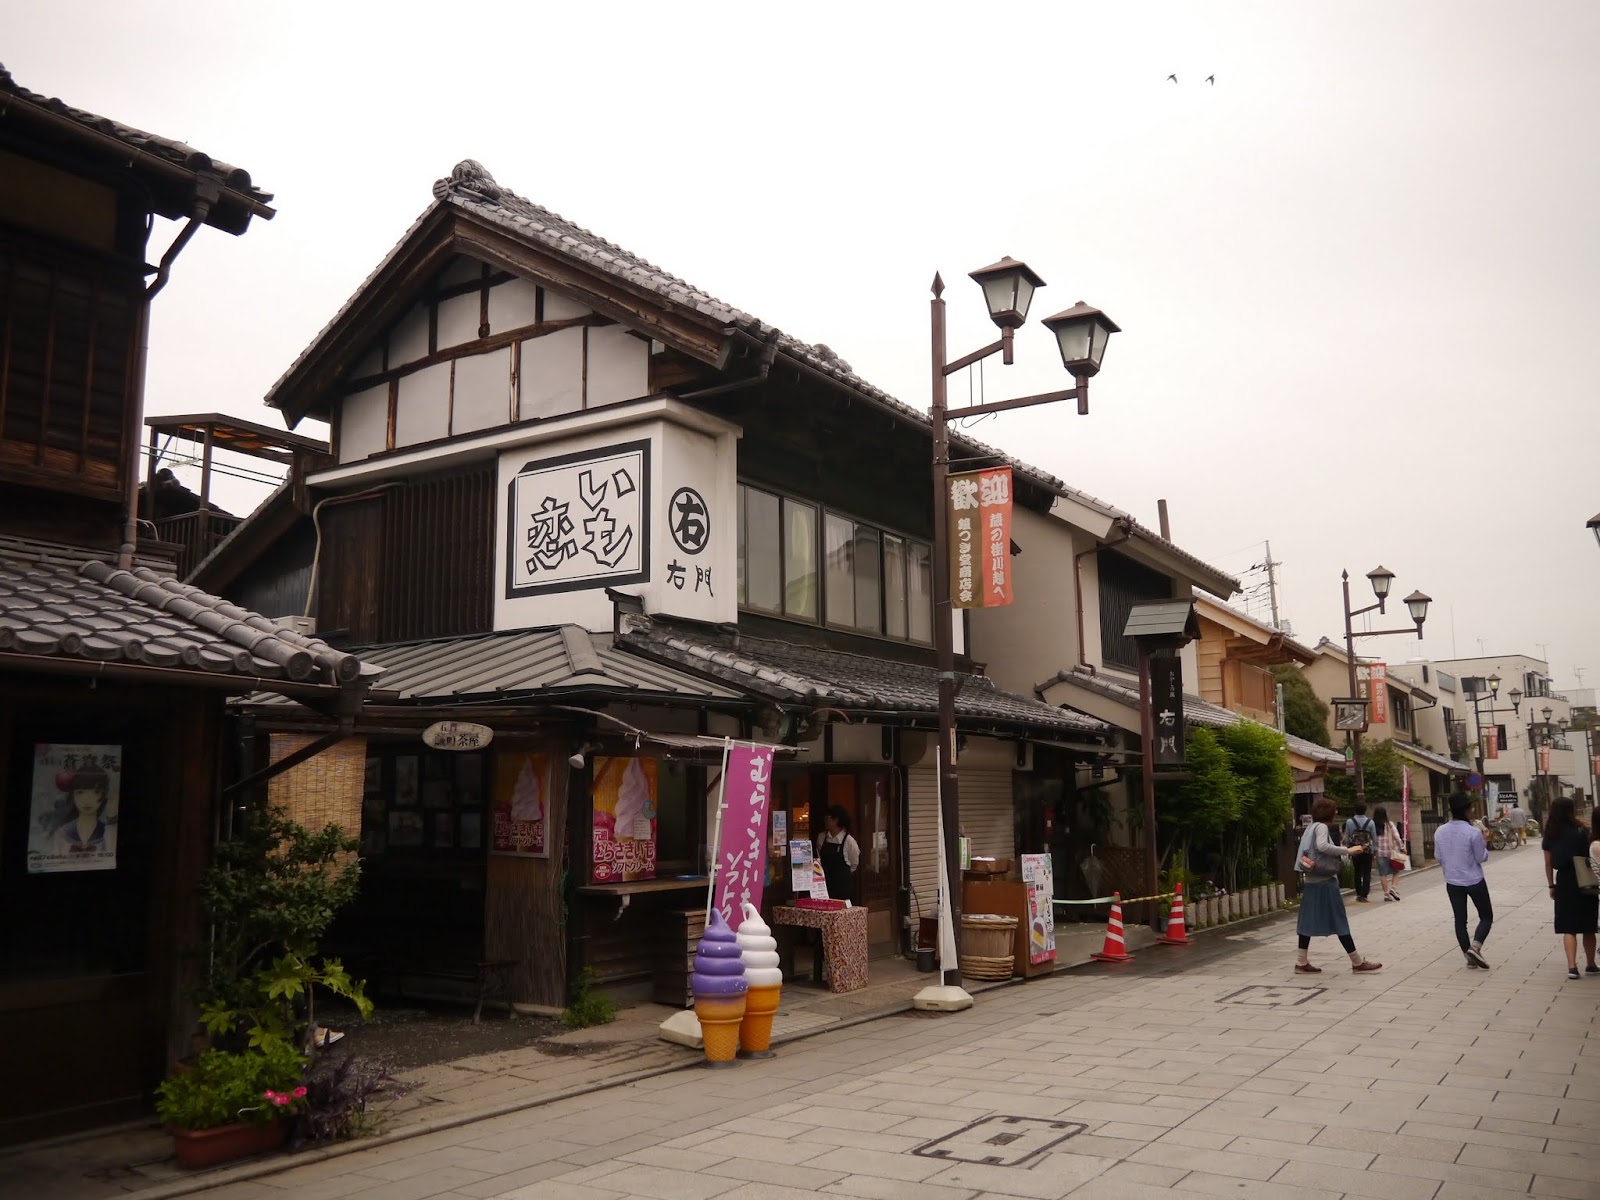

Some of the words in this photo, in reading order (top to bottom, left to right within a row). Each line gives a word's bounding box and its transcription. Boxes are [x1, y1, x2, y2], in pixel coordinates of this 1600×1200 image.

[950, 474, 1010, 511] 歓迎
[666, 558, 715, 598] 右門
[1159, 708, 1177, 754] 右門
[593, 841, 655, 862] むらさきいも
[611, 860, 655, 874] ソフトクリーム
